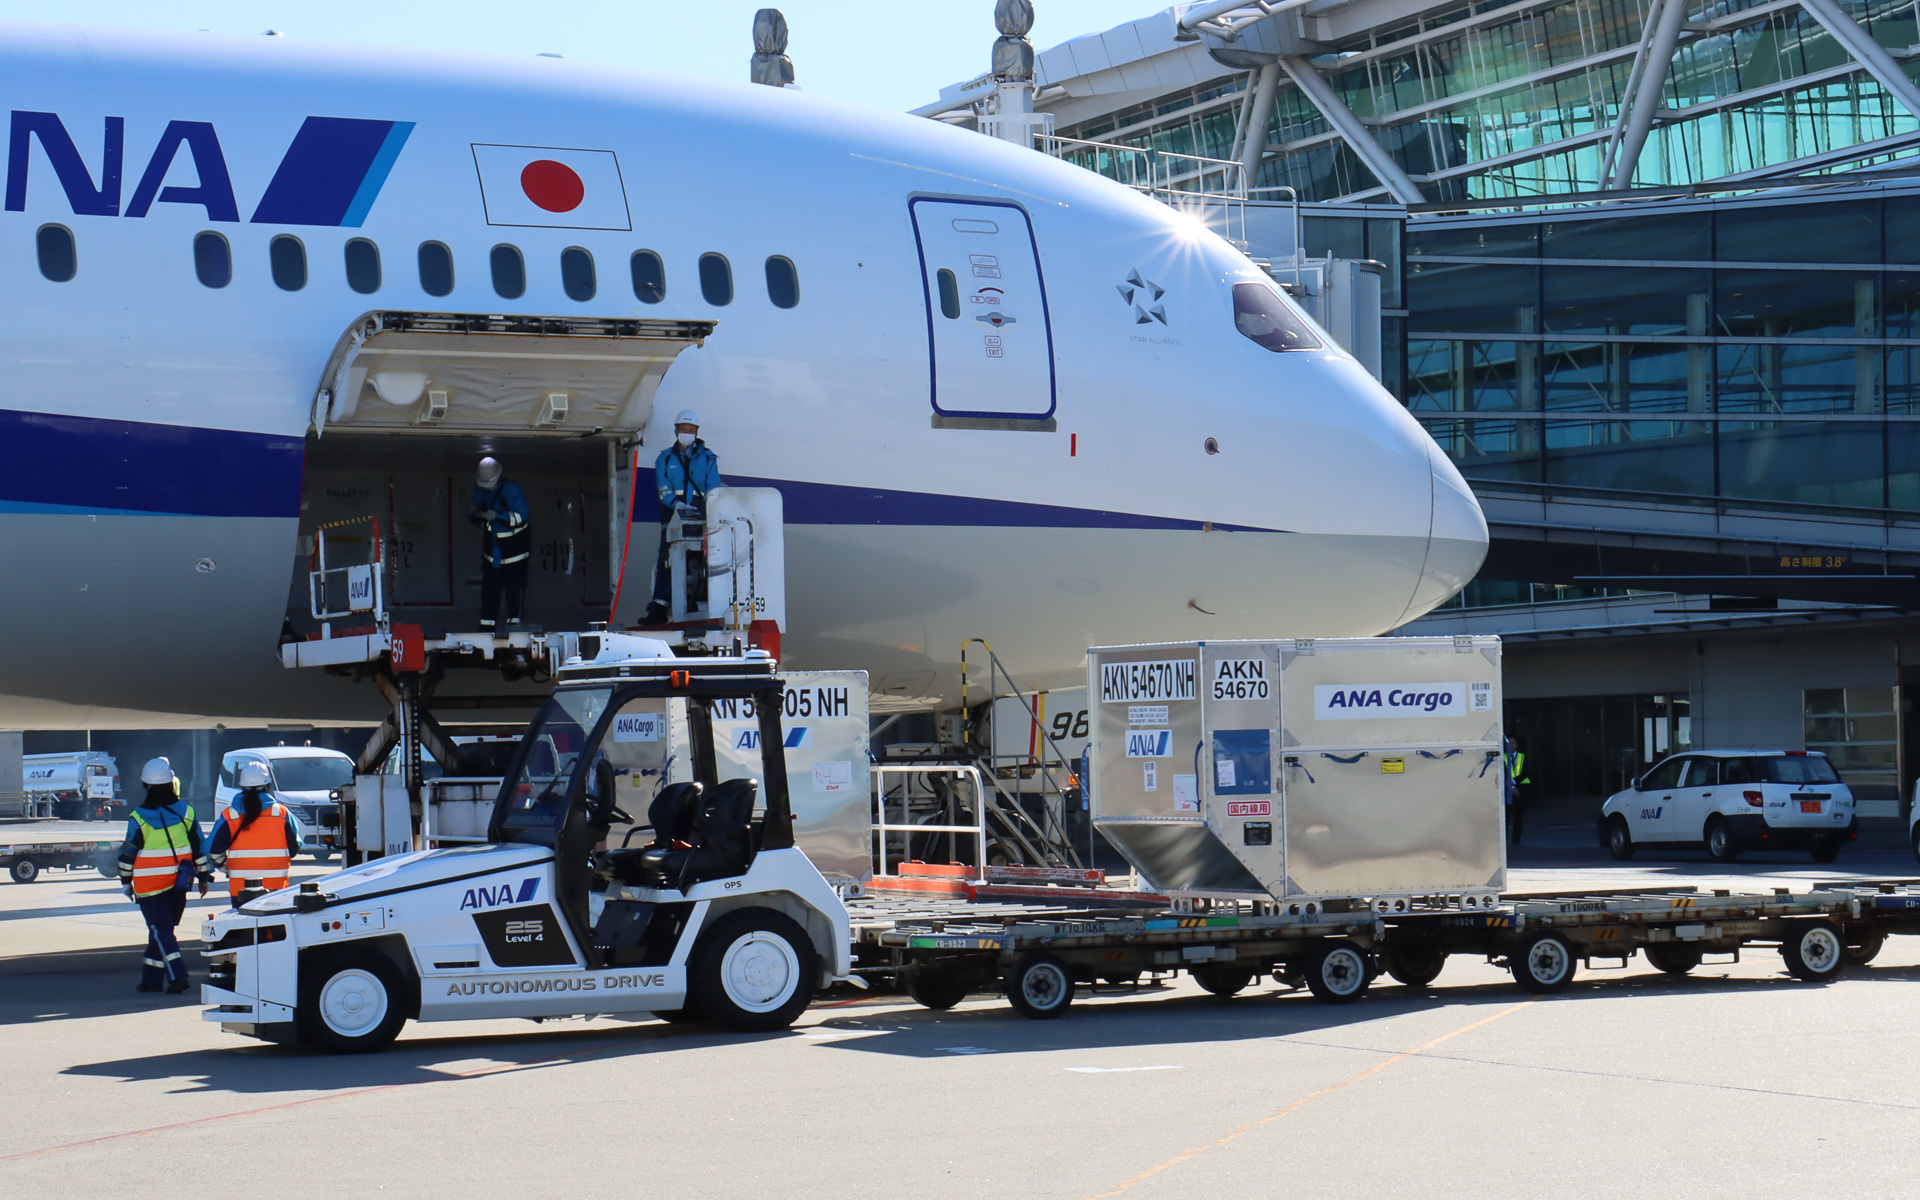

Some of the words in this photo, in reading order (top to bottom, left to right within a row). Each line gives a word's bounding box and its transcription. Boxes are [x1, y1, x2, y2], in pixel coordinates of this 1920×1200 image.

[4, 110, 241, 222] NA
[1129, 335, 1147, 343] STAR
[1149, 337, 1182, 346] ALLIANCE
[988, 348, 1000, 356] EXIT
[401, 541, 414, 553] 12
[1780, 556, 1822, 568] 高さ制限
[350, 581, 365, 599] ANA
[392, 639, 404, 663] 59
[1218, 660, 1263, 680] AKN
[1103, 664, 1129, 700] AKN
[1131, 662, 1173, 699] 54670
[1175, 661, 1195, 698] NH
[1214, 680, 1268, 700] 54670
[742, 688, 812, 719] 505
[817, 687, 849, 717] NH
[1328, 689, 1383, 708] ANA
[1388, 689, 1453, 712] Cargo
[617, 718, 634, 733] ANA
[634, 718, 654, 737] Cargo
[1050, 709, 1089, 741] 98
[1128, 734, 1155, 757] ANA
[29, 770, 46, 779] ANA
[1230, 803, 1269, 814] 国内線用
[1640, 808, 1657, 820] ANA
[724, 880, 743, 890] OPS
[459, 884, 513, 911] ANA
[505, 920, 543, 934] 25
[505, 934, 533, 944] Level
[534, 933, 544, 942] 4
[446, 977, 597, 997] AUTONOMOUS
[603, 973, 665, 990] DRIVE
